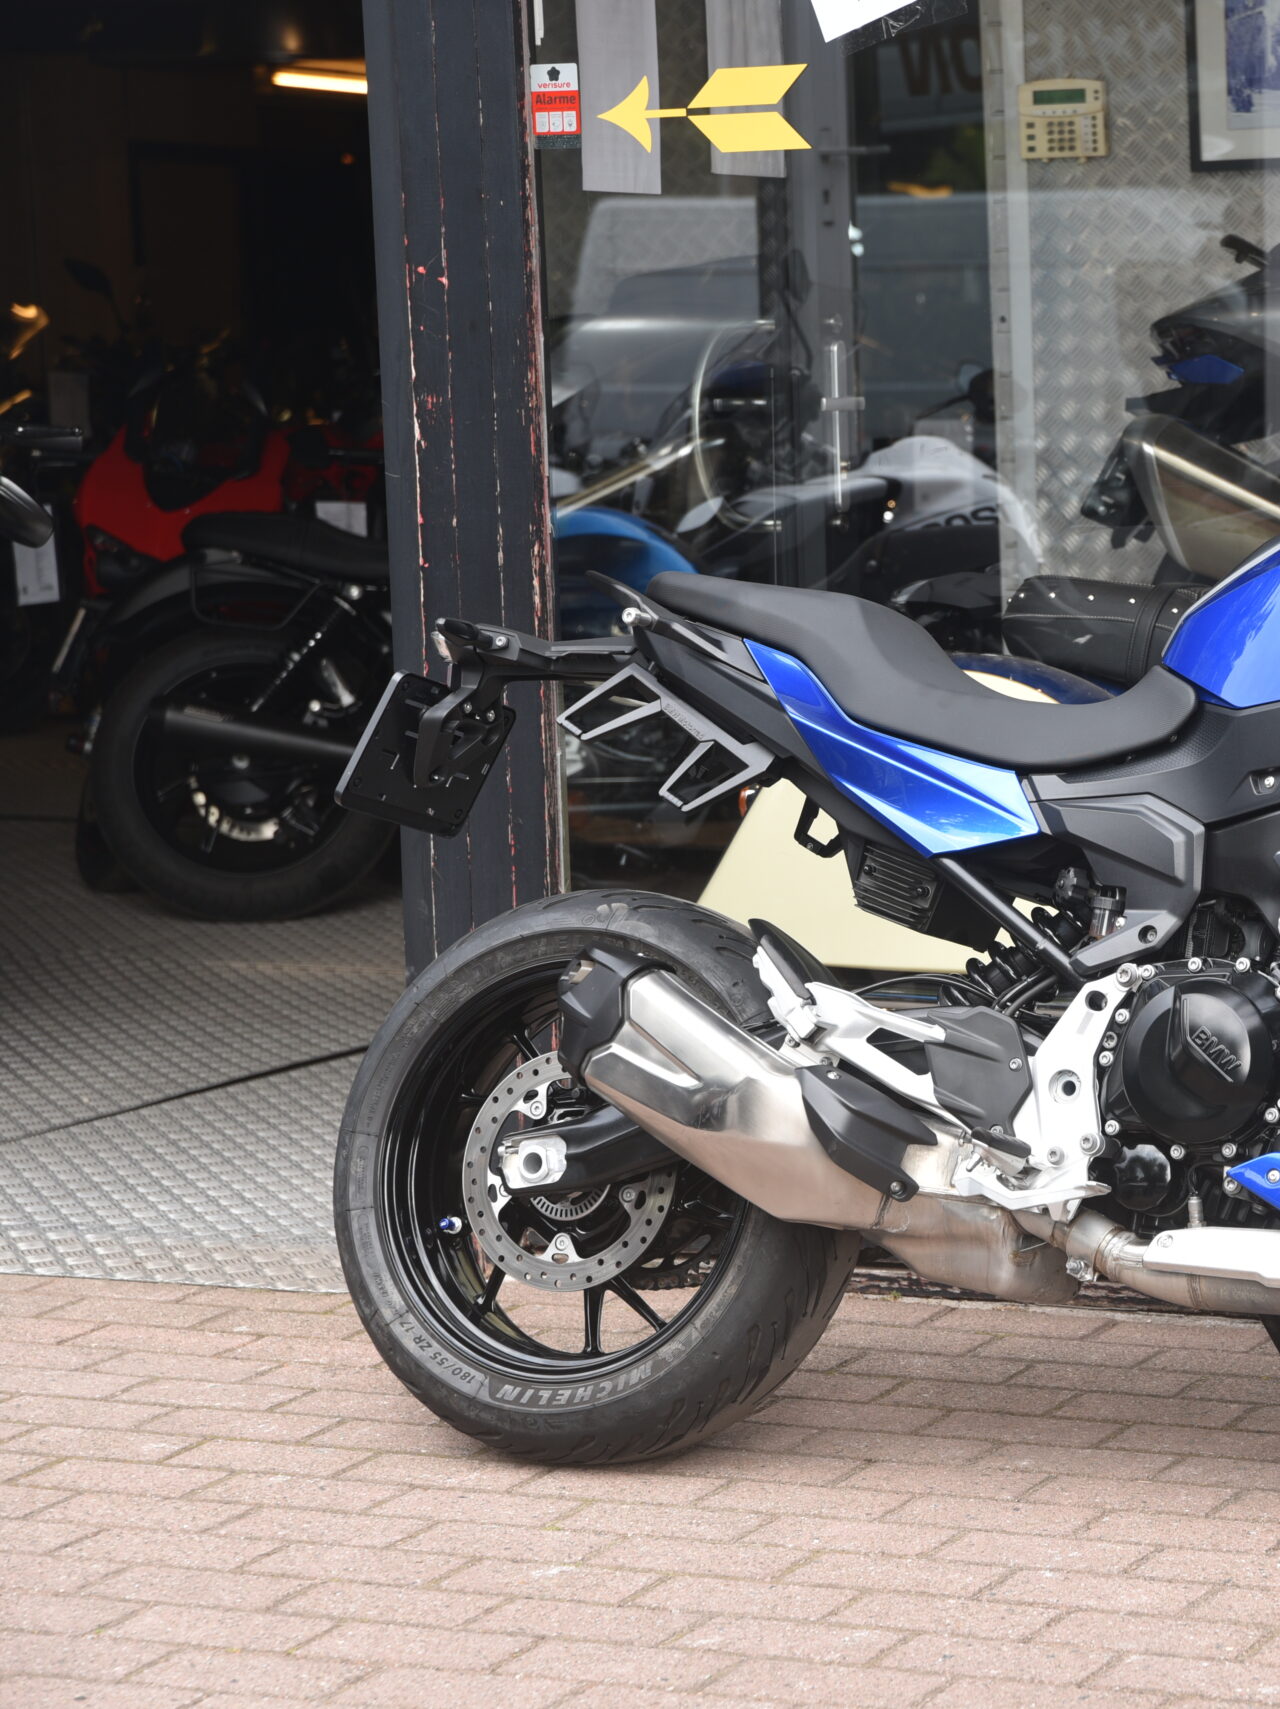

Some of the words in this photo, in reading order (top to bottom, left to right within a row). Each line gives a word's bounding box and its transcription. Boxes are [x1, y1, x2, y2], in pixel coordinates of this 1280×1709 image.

[537, 81, 571, 89] verisure
[535, 93, 576, 105] Alarme
[1191, 1025, 1242, 1071] BMW
[400, 1319, 414, 1331] 17
[412, 1333, 433, 1352] ZR
[429, 1349, 476, 1385] 180/55
[496, 1363, 652, 1405] MICHELIN
